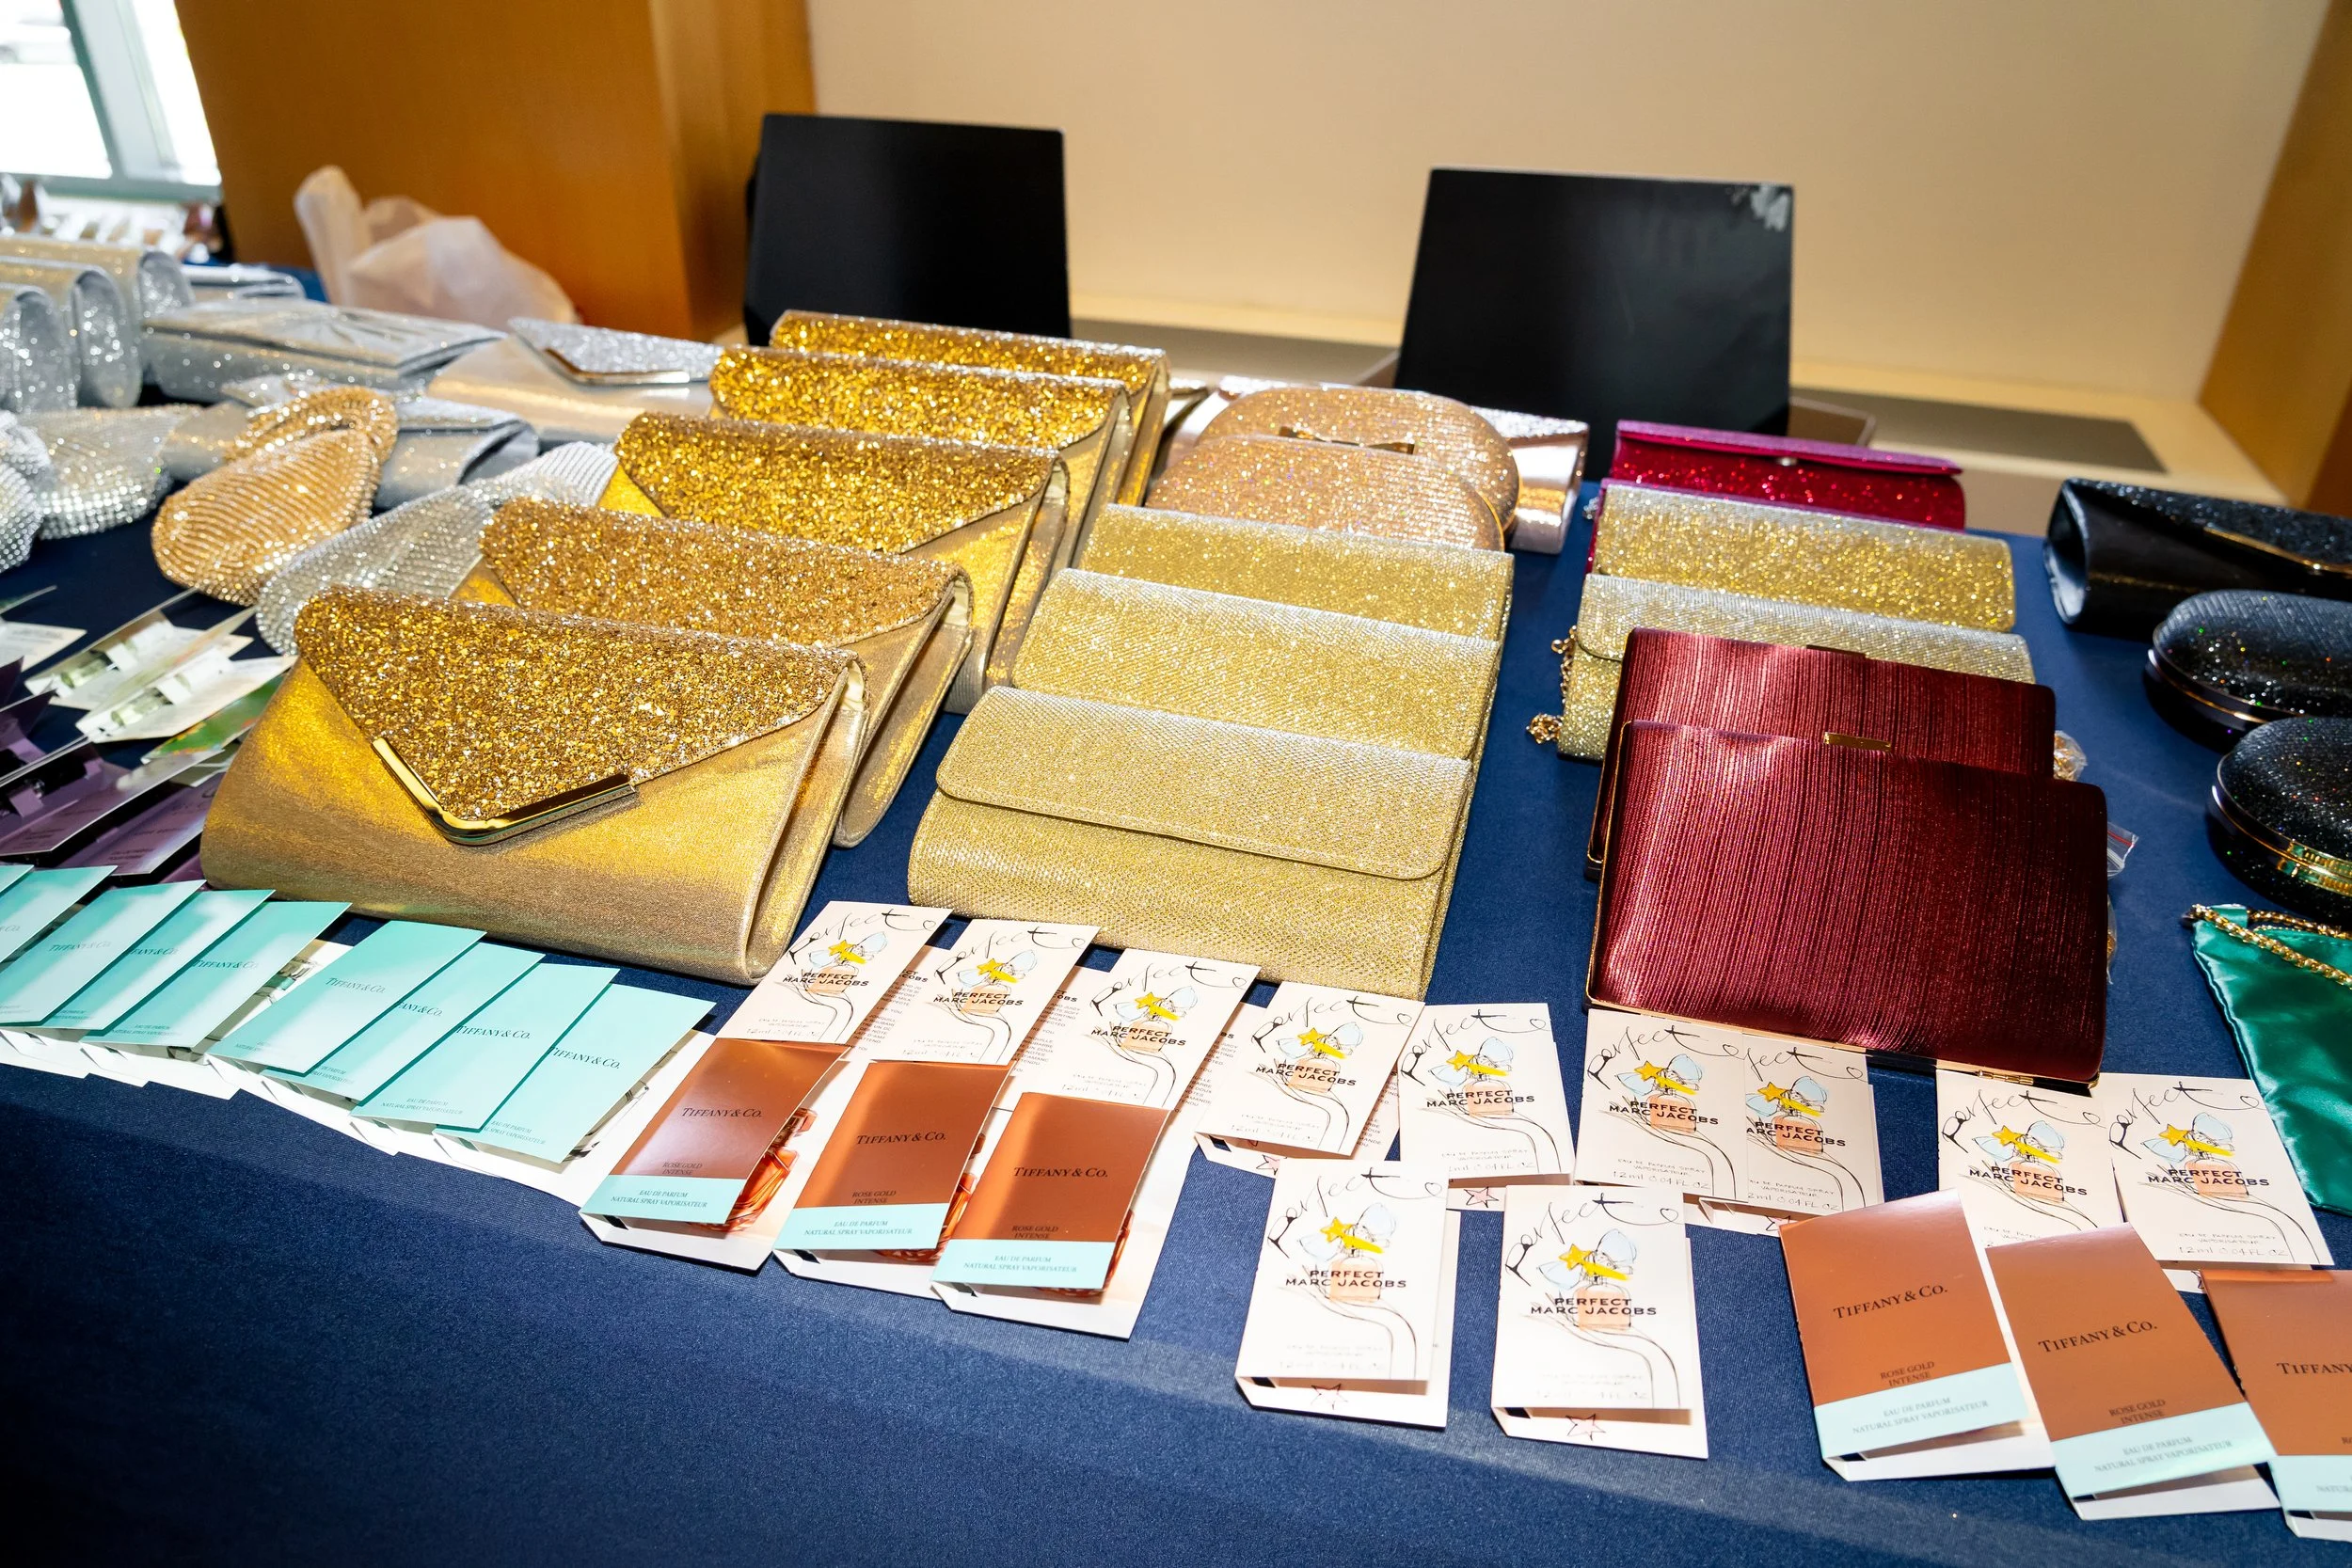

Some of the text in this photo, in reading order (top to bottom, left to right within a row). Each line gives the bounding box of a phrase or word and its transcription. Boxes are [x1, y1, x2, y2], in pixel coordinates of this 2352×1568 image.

[803, 972, 857, 980] PERFECT
[818, 978, 869, 987] JACOBS
[933, 996, 1024, 1006] MARC JACOBS
[953, 991, 1011, 1000] PERFECT
[456, 1024, 502, 1037] TIFFANY
[1111, 1025, 1172, 1037] PERFECT
[1090, 1029, 1186, 1046] MARC JACOBS
[547, 1046, 594, 1063] TIFFANY
[1277, 1063, 1341, 1076] PERFECT
[1255, 1067, 1357, 1085] MARC JACOBS
[1446, 1089, 1513, 1100] PERFECT
[1426, 1095, 1535, 1108] MARC JACOBS
[1629, 1100, 1697, 1115] PERFECT
[681, 1107, 732, 1117] TIFFANY
[1609, 1103, 1719, 1125] MARC JACOBS
[1754, 1120, 1823, 1135] PERFECT
[856, 1133, 913, 1145] TIFFANY
[1782, 1131, 1846, 1147] JACOBS
[1013, 1166, 1072, 1177] TIFFANY
[1991, 1165, 2064, 1183] PERFECT
[2168, 1168, 2242, 1179] PERFECT
[1968, 1167, 2088, 1196] MARC JACOBS
[2147, 1175, 2269, 1186] MARC JACOBS
[1310, 1270, 1384, 1278] PERFECT
[1285, 1277, 1406, 1289] MARC JACOBS
[1554, 1297, 1631, 1307] PERFECT
[1833, 1294, 1900, 1319] TIFFANY
[1531, 1306, 1657, 1316] MARC JACOBS
[2039, 1327, 2110, 1353] TIFFANY
